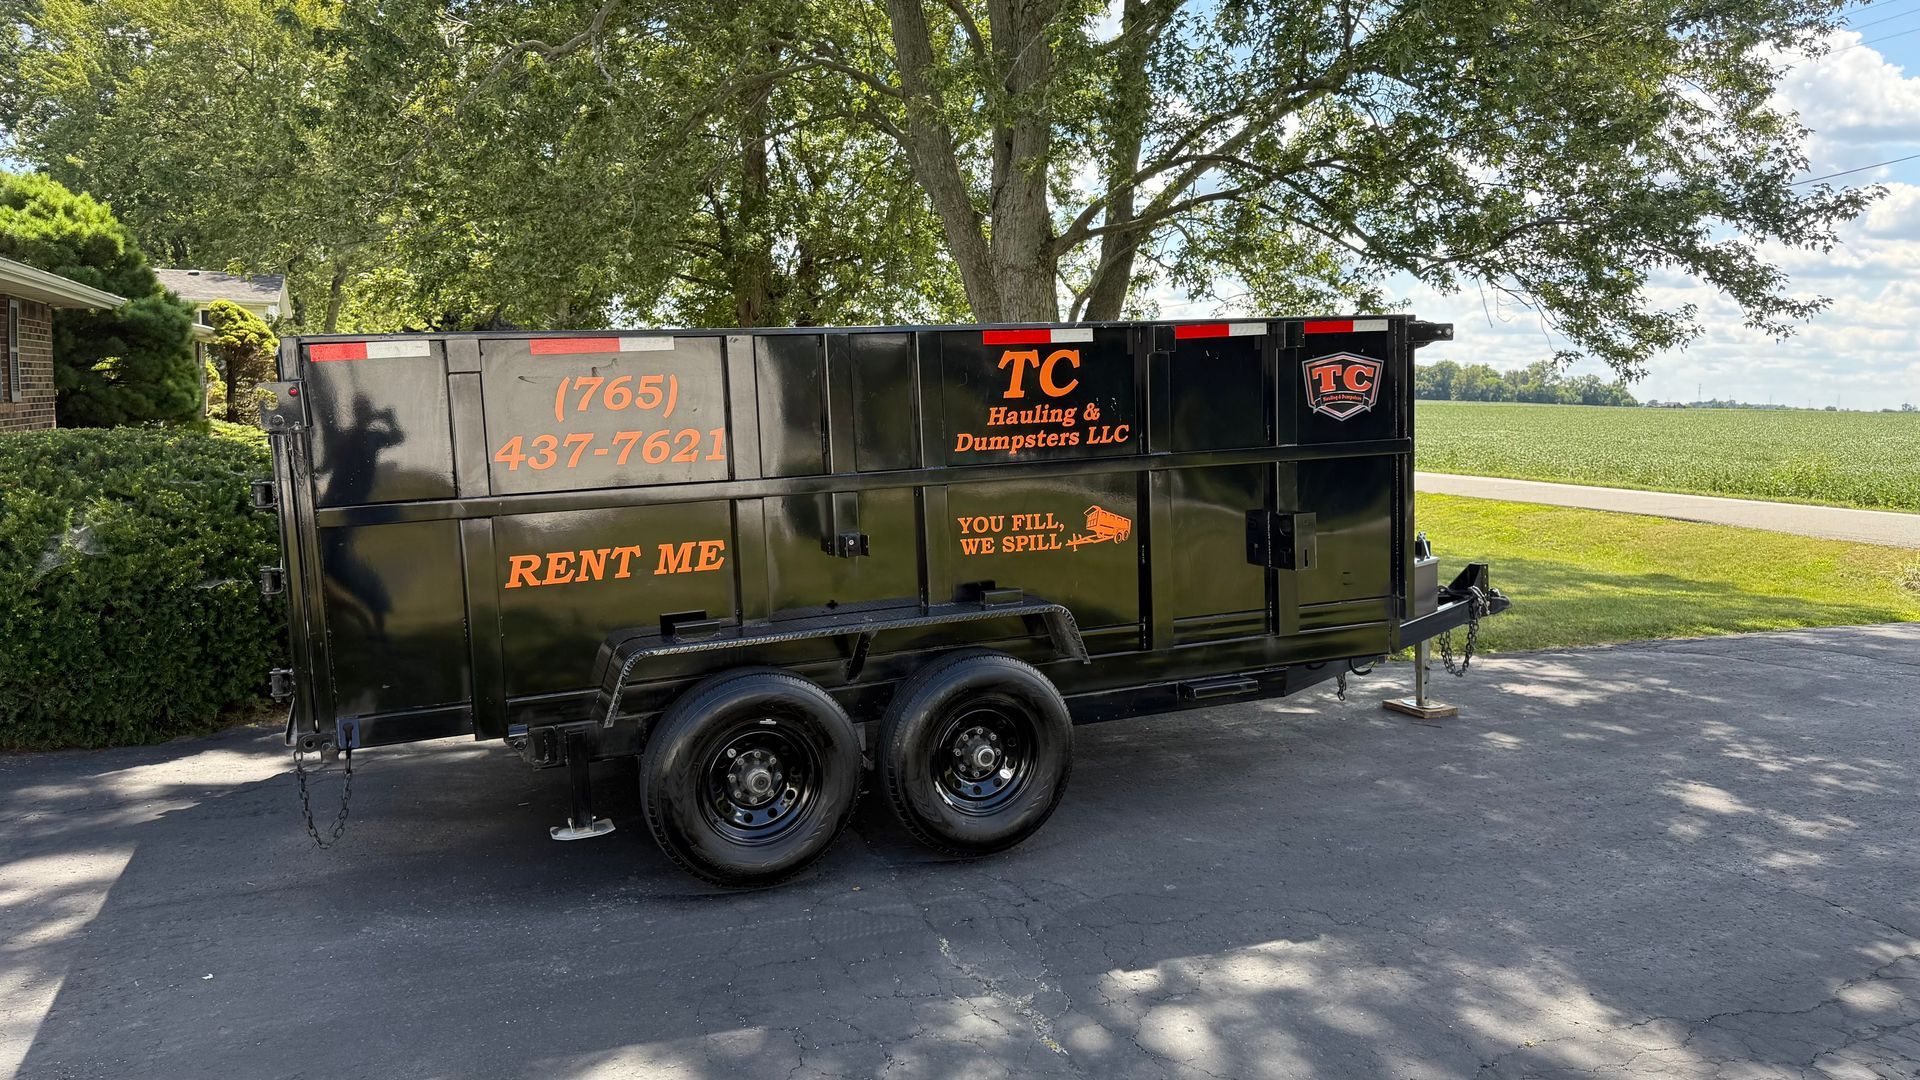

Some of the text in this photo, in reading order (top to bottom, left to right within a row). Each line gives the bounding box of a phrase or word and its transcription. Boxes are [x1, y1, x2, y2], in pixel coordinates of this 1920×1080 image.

[998, 349, 1081, 399] TC
[1311, 364, 1375, 393] TC
[554, 374, 679, 423] (765)
[986, 402, 1101, 427] Hauling &
[494, 427, 726, 471] 437-7621
[954, 424, 1130, 455] Dumpsters LLC
[957, 512, 1065, 534] YOU FILL,
[960, 533, 1062, 556] WE SPILL
[504, 539, 726, 589] RENT ME
